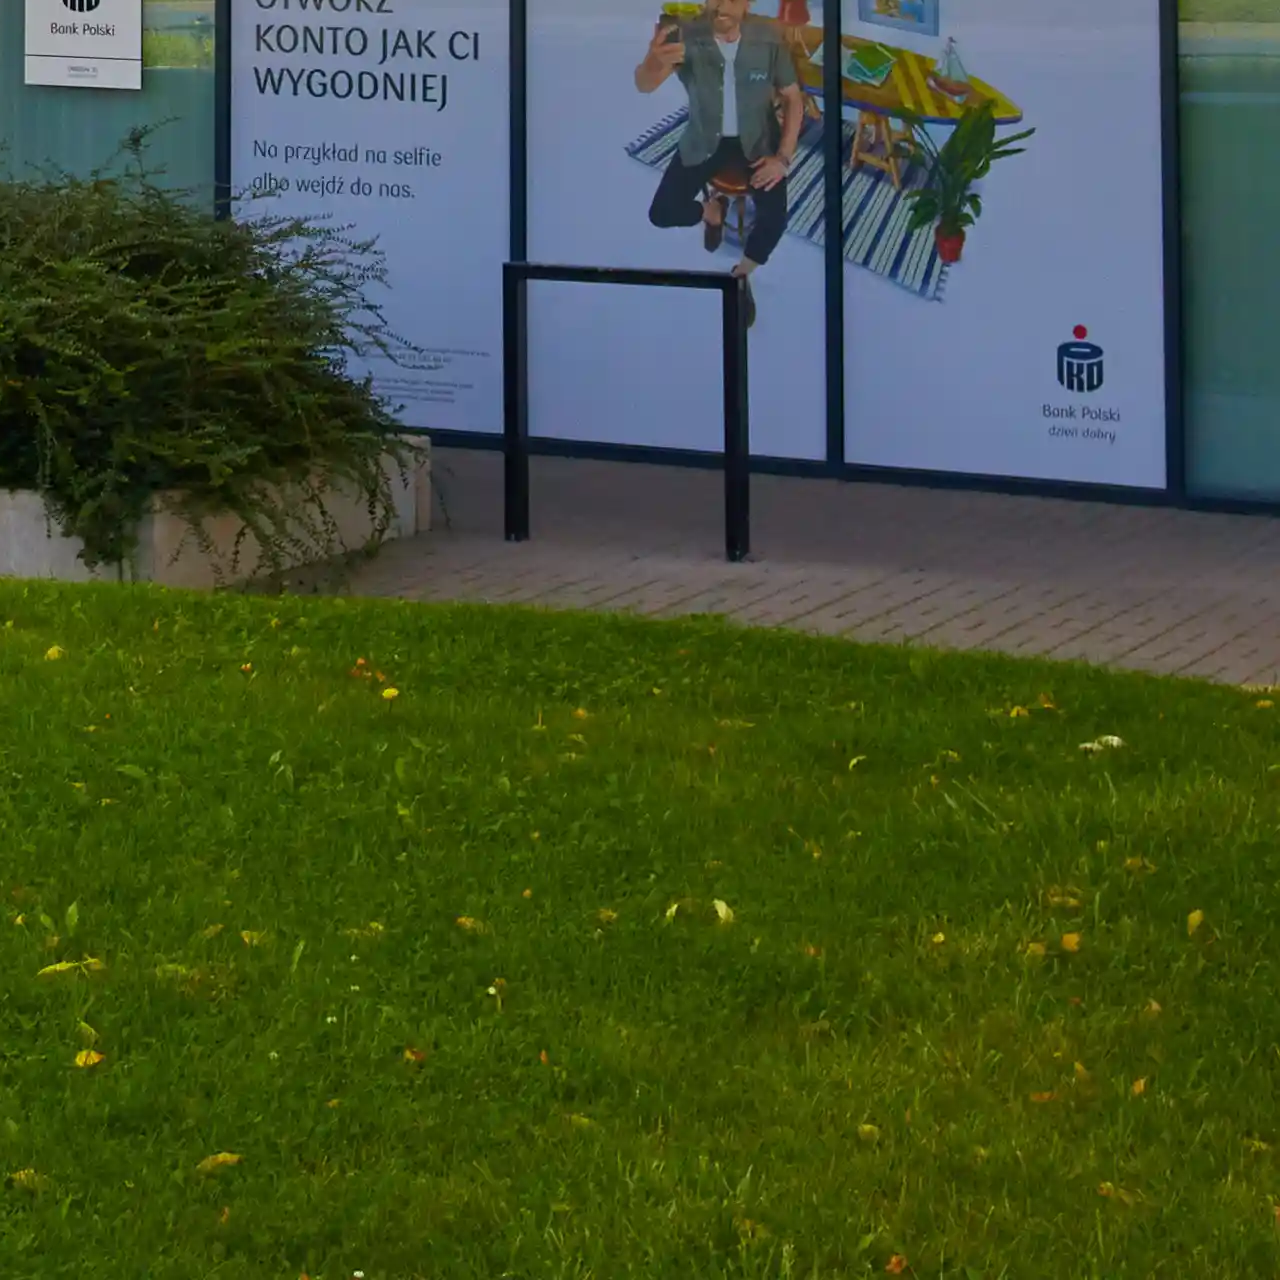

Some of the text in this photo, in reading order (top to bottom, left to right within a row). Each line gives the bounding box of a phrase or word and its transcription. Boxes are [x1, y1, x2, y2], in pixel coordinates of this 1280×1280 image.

[50, 22, 116, 37] Bank Polski
[256, 24, 479, 65] KONTO JAK CI
[253, 66, 448, 112] WYGODNIEJ
[253, 140, 442, 167] Na przykład na selfie
[252, 172, 416, 199] albo wejdź do nas.
[1042, 404, 1121, 422] Bank Polski
